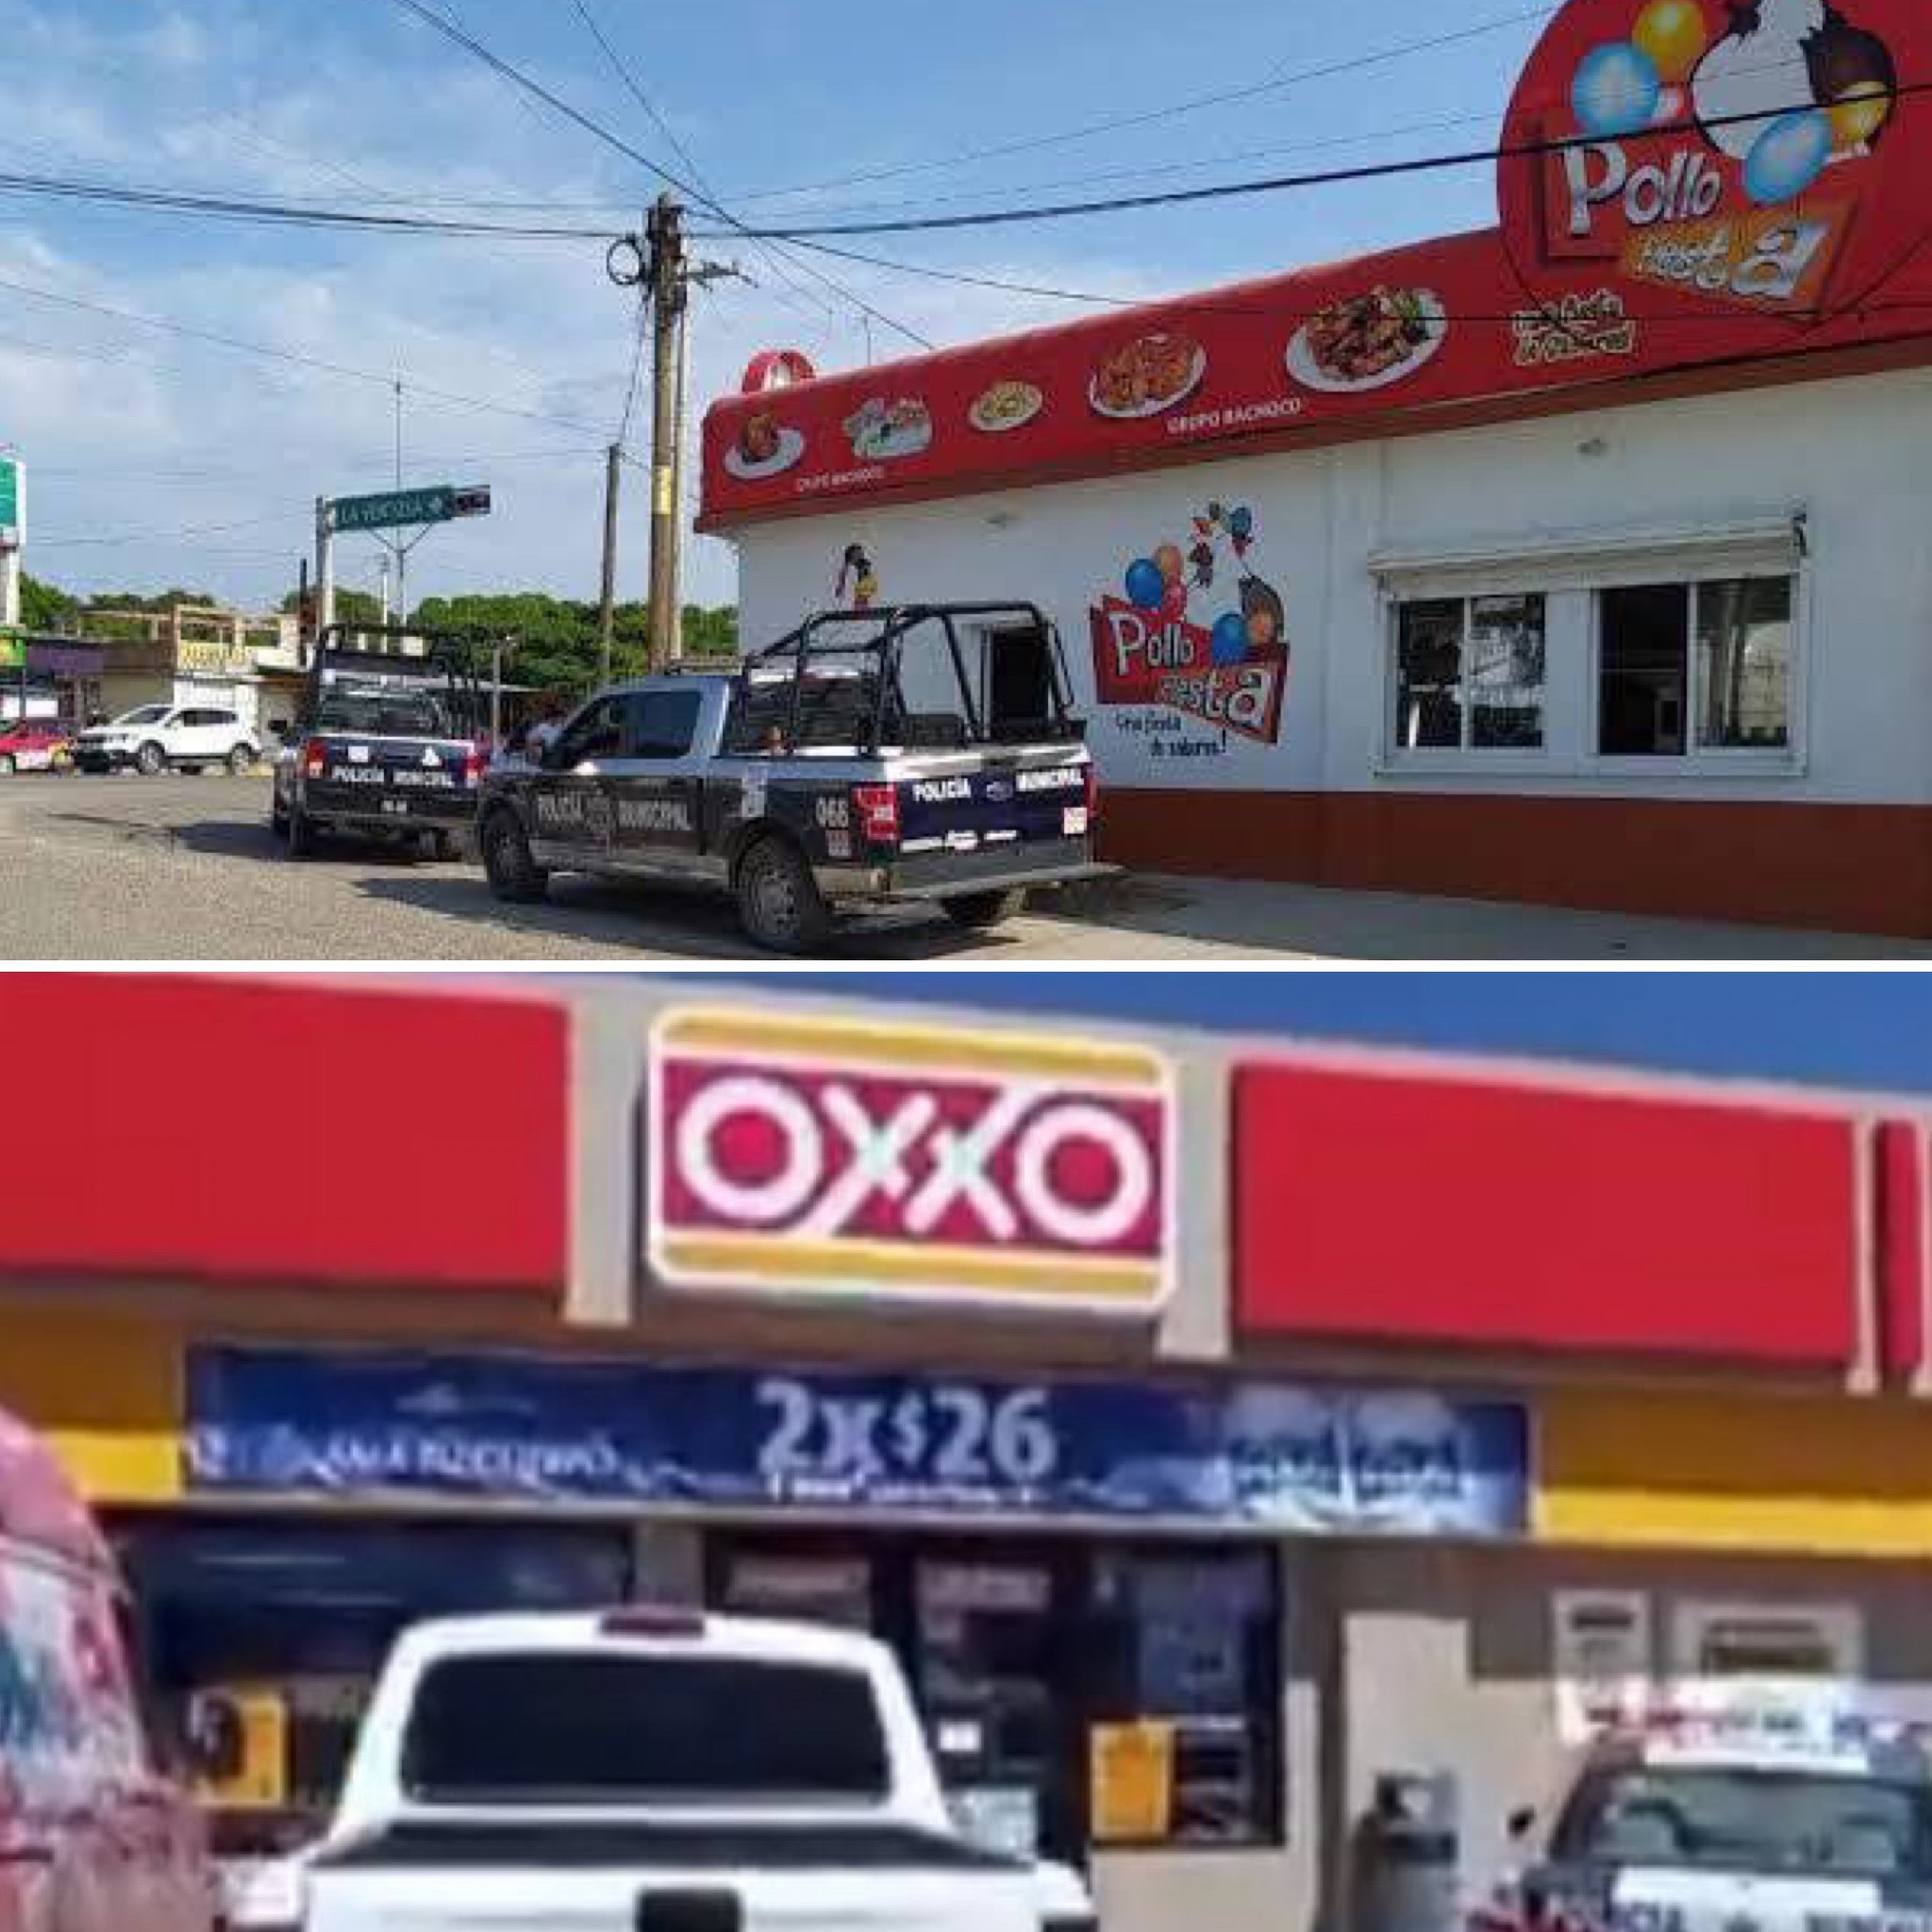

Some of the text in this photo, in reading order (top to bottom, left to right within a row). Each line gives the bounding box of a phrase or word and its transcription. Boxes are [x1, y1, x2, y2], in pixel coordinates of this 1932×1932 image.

[1562, 142, 1723, 238] Pollo
[1108, 611, 1194, 676] Pollo
[675, 1074, 1153, 1244] OXXO
